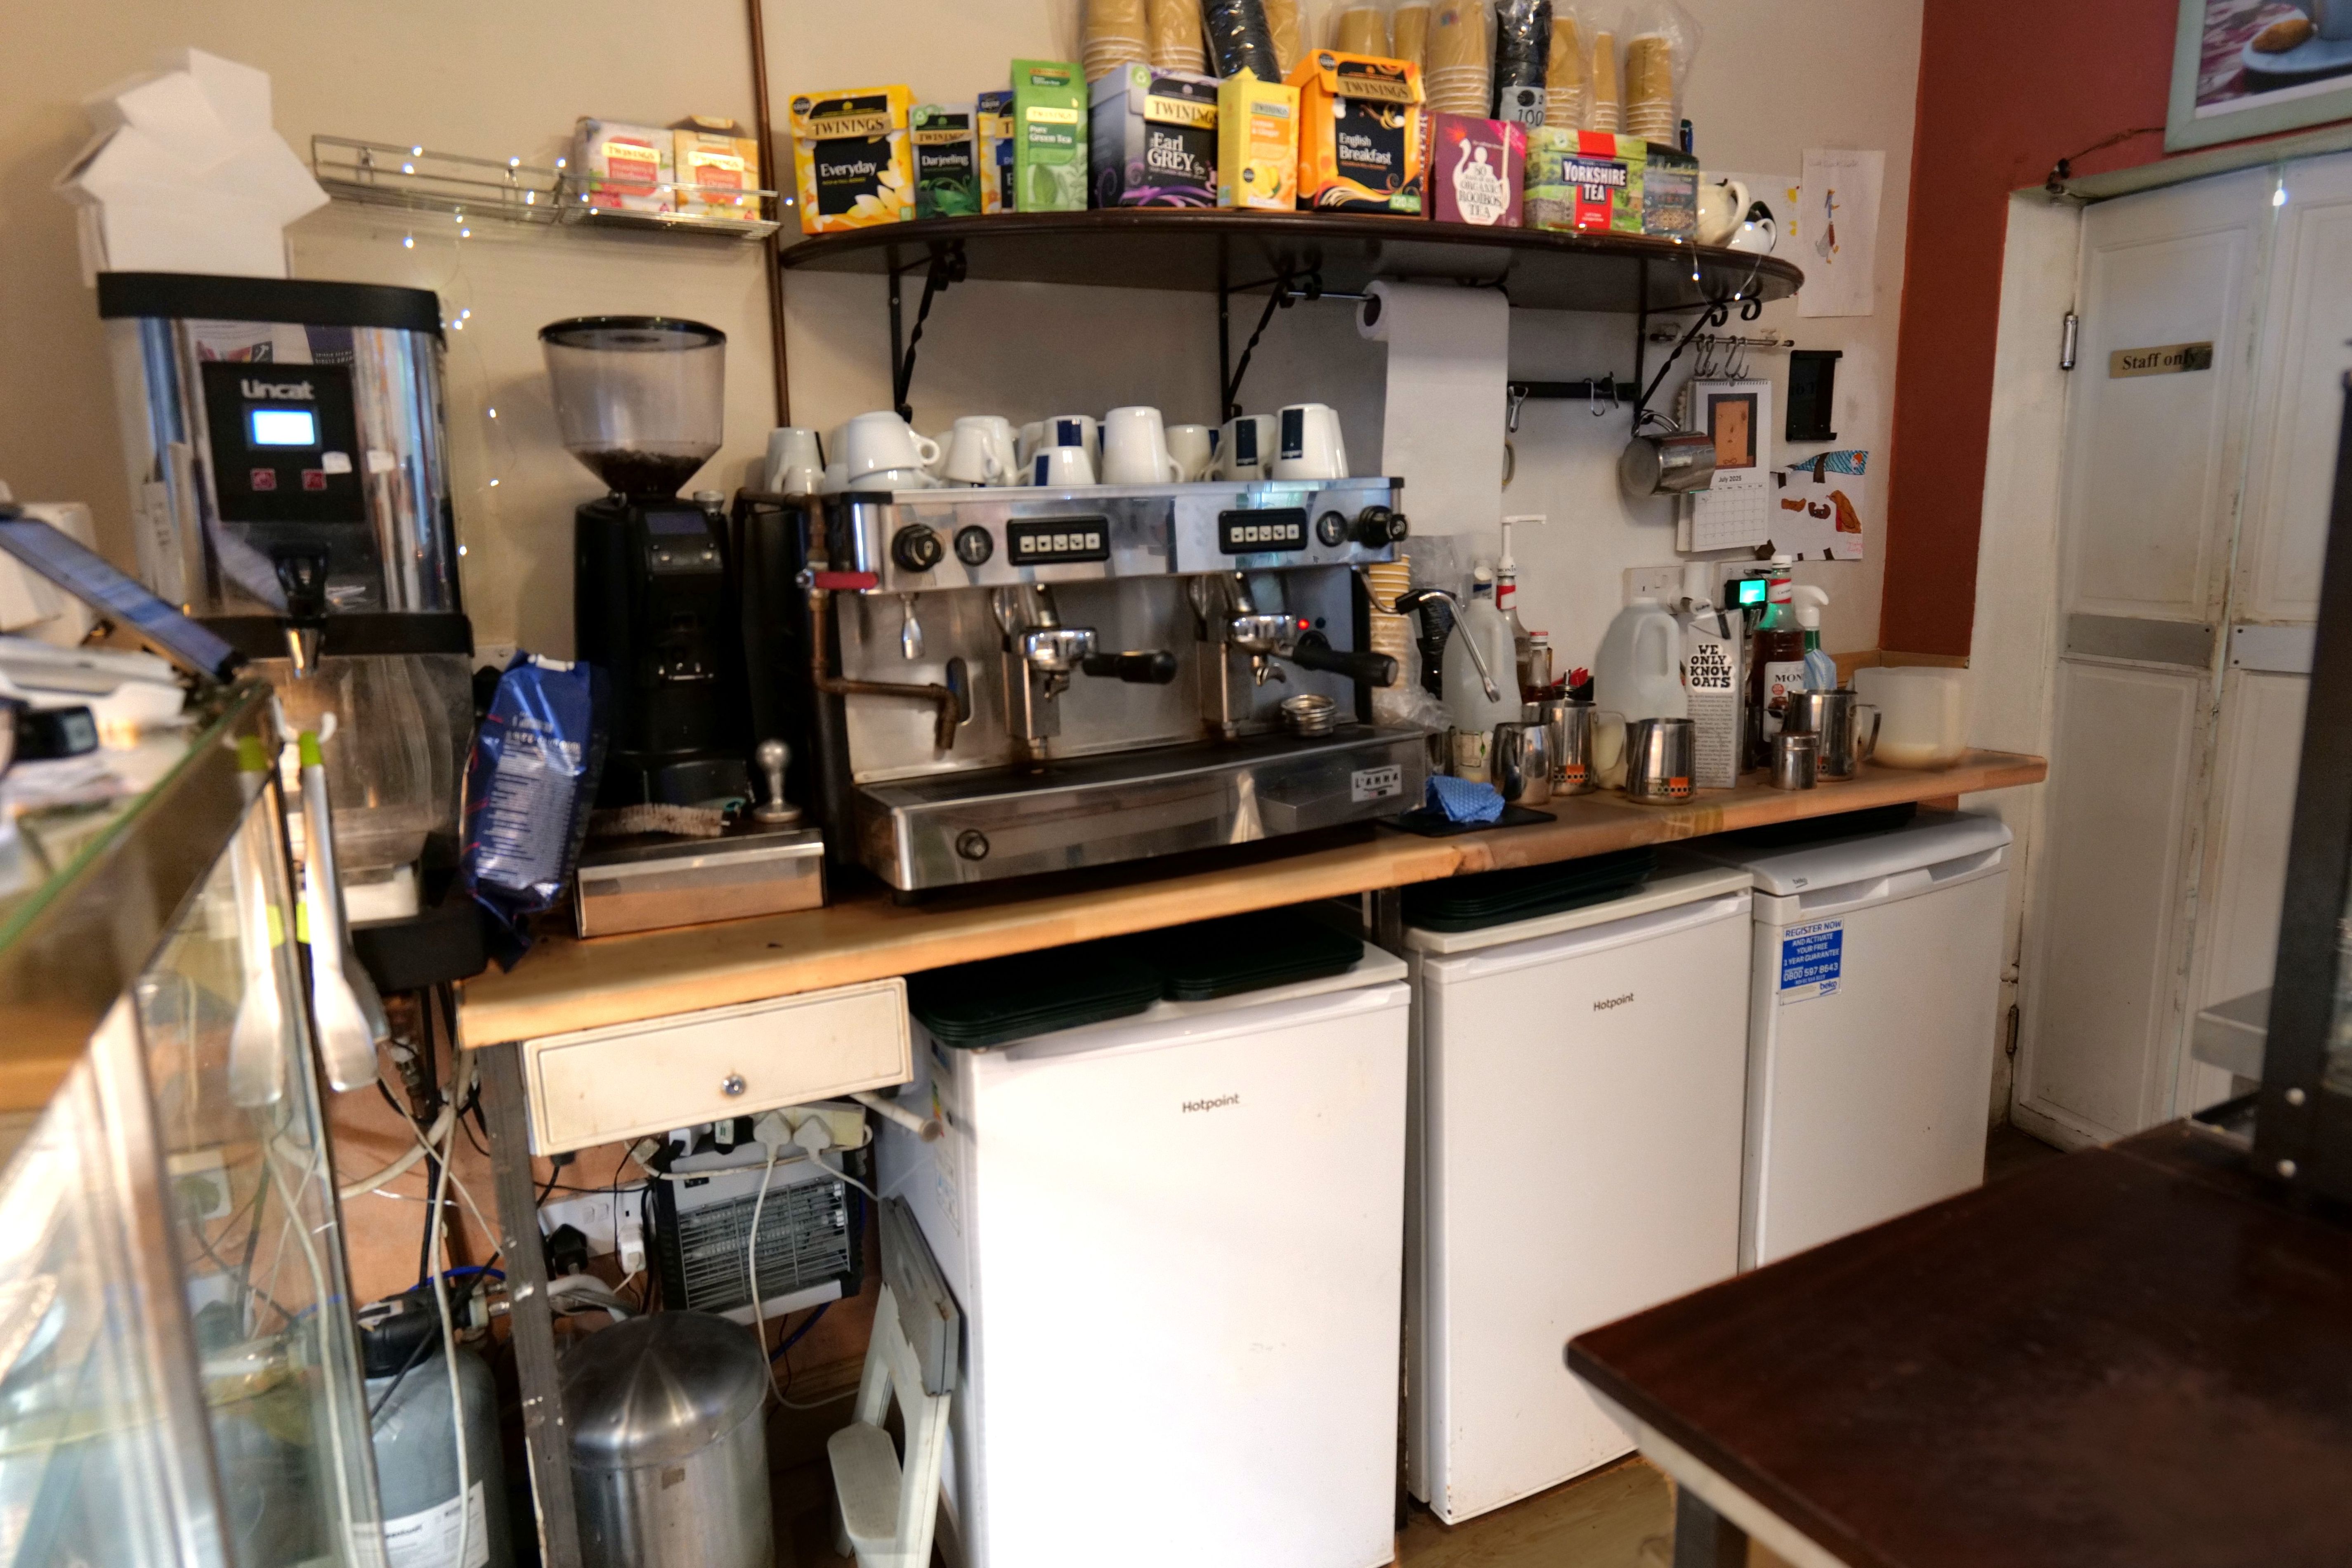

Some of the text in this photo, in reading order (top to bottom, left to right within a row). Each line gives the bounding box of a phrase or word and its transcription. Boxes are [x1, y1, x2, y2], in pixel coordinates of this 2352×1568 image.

[1345, 80, 1408, 98] TWININGS
[1517, 109, 1544, 126] 100
[815, 119, 884, 135] TWININGS
[1029, 133, 1072, 144] Green Tea
[1154, 132, 1183, 152] Earl
[1339, 132, 1372, 148] English
[921, 154, 969, 167] Darjeeling
[1147, 147, 1195, 172] GREY
[1339, 145, 1391, 165] Breakfast
[820, 160, 876, 177] Everyday
[1564, 161, 1627, 185] YORKSHIRE
[1584, 184, 1606, 202] TEA
[2123, 352, 2161, 370] Staff
[1698, 645, 1718, 654] WE
[1691, 655, 1726, 665] ONLY
[1690, 666, 1731, 676] KNOW
[1776, 673, 1802, 682] MON
[1692, 677, 1731, 688] OATS
[1786, 920, 1842, 937] REGISTER NOW
[1792, 933, 1834, 947] AND ACTIVATE
[1797, 942, 1829, 954] YOUR FREE
[1788, 956, 1804, 965] YEAR
[1805, 949, 1840, 961] GUARANTEE
[1784, 970, 1803, 981] 0800
[1804, 966, 1818, 976] 597
[1819, 962, 1838, 973] 8643
[1820, 981, 1837, 990] beko
[1594, 993, 1634, 1011] Hotpoint
[1182, 1093, 1240, 1113] Hotpoint
